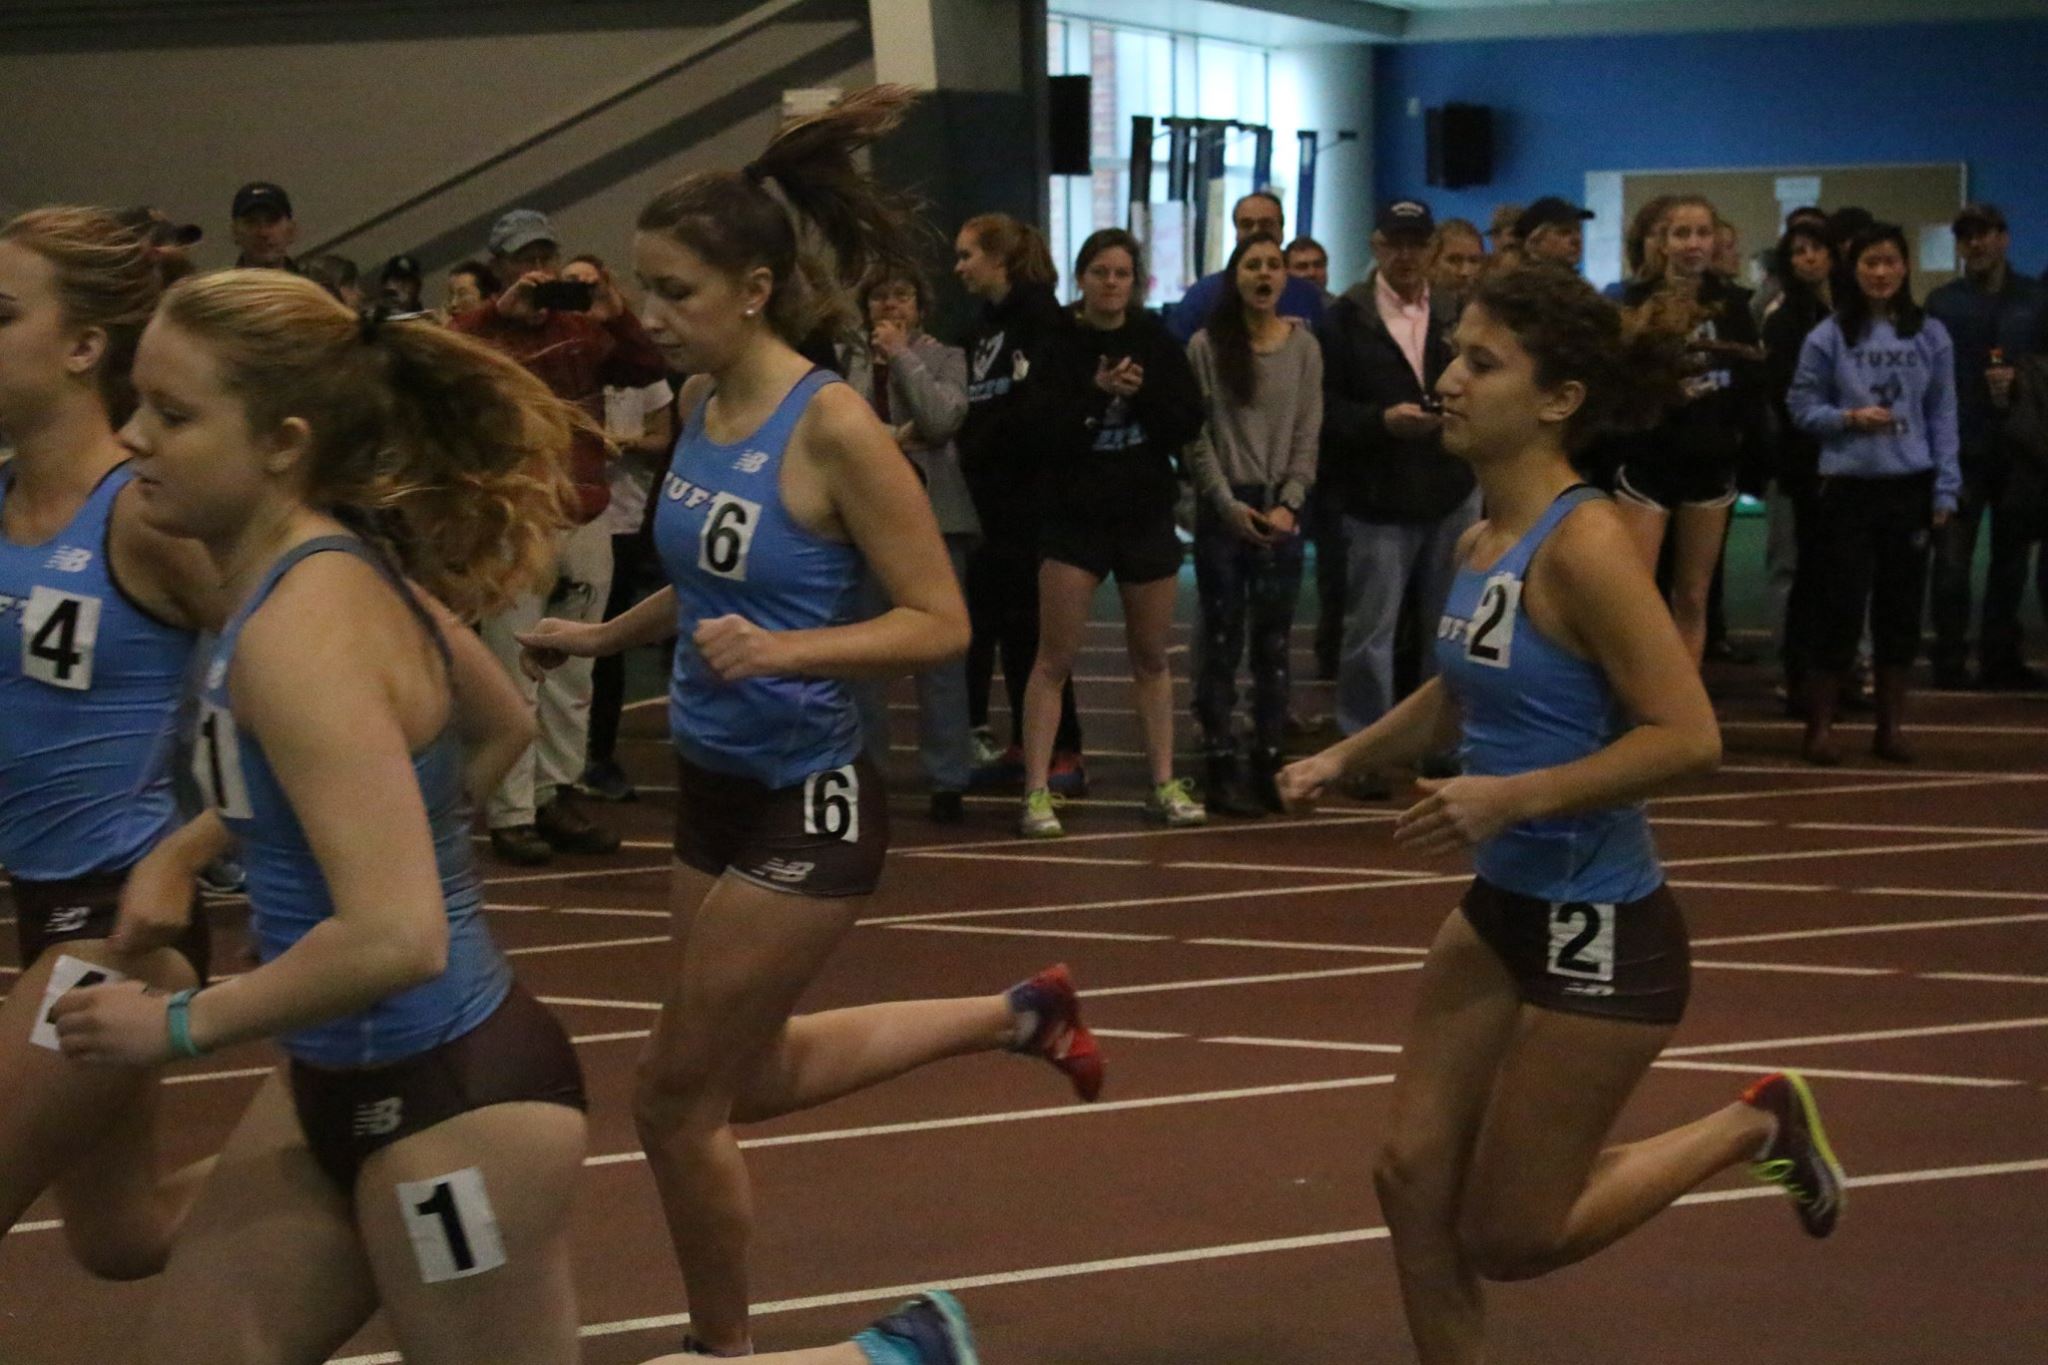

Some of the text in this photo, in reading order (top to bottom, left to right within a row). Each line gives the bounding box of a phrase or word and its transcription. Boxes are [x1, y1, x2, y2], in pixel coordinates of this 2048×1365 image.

[706, 502, 747, 573] 6
[29, 598, 82, 681] 4
[1470, 584, 1506, 661] 2
[203, 711, 229, 810] 1
[812, 769, 851, 841] 6
[1555, 901, 1601, 974] 2
[416, 1181, 475, 1272] 1
